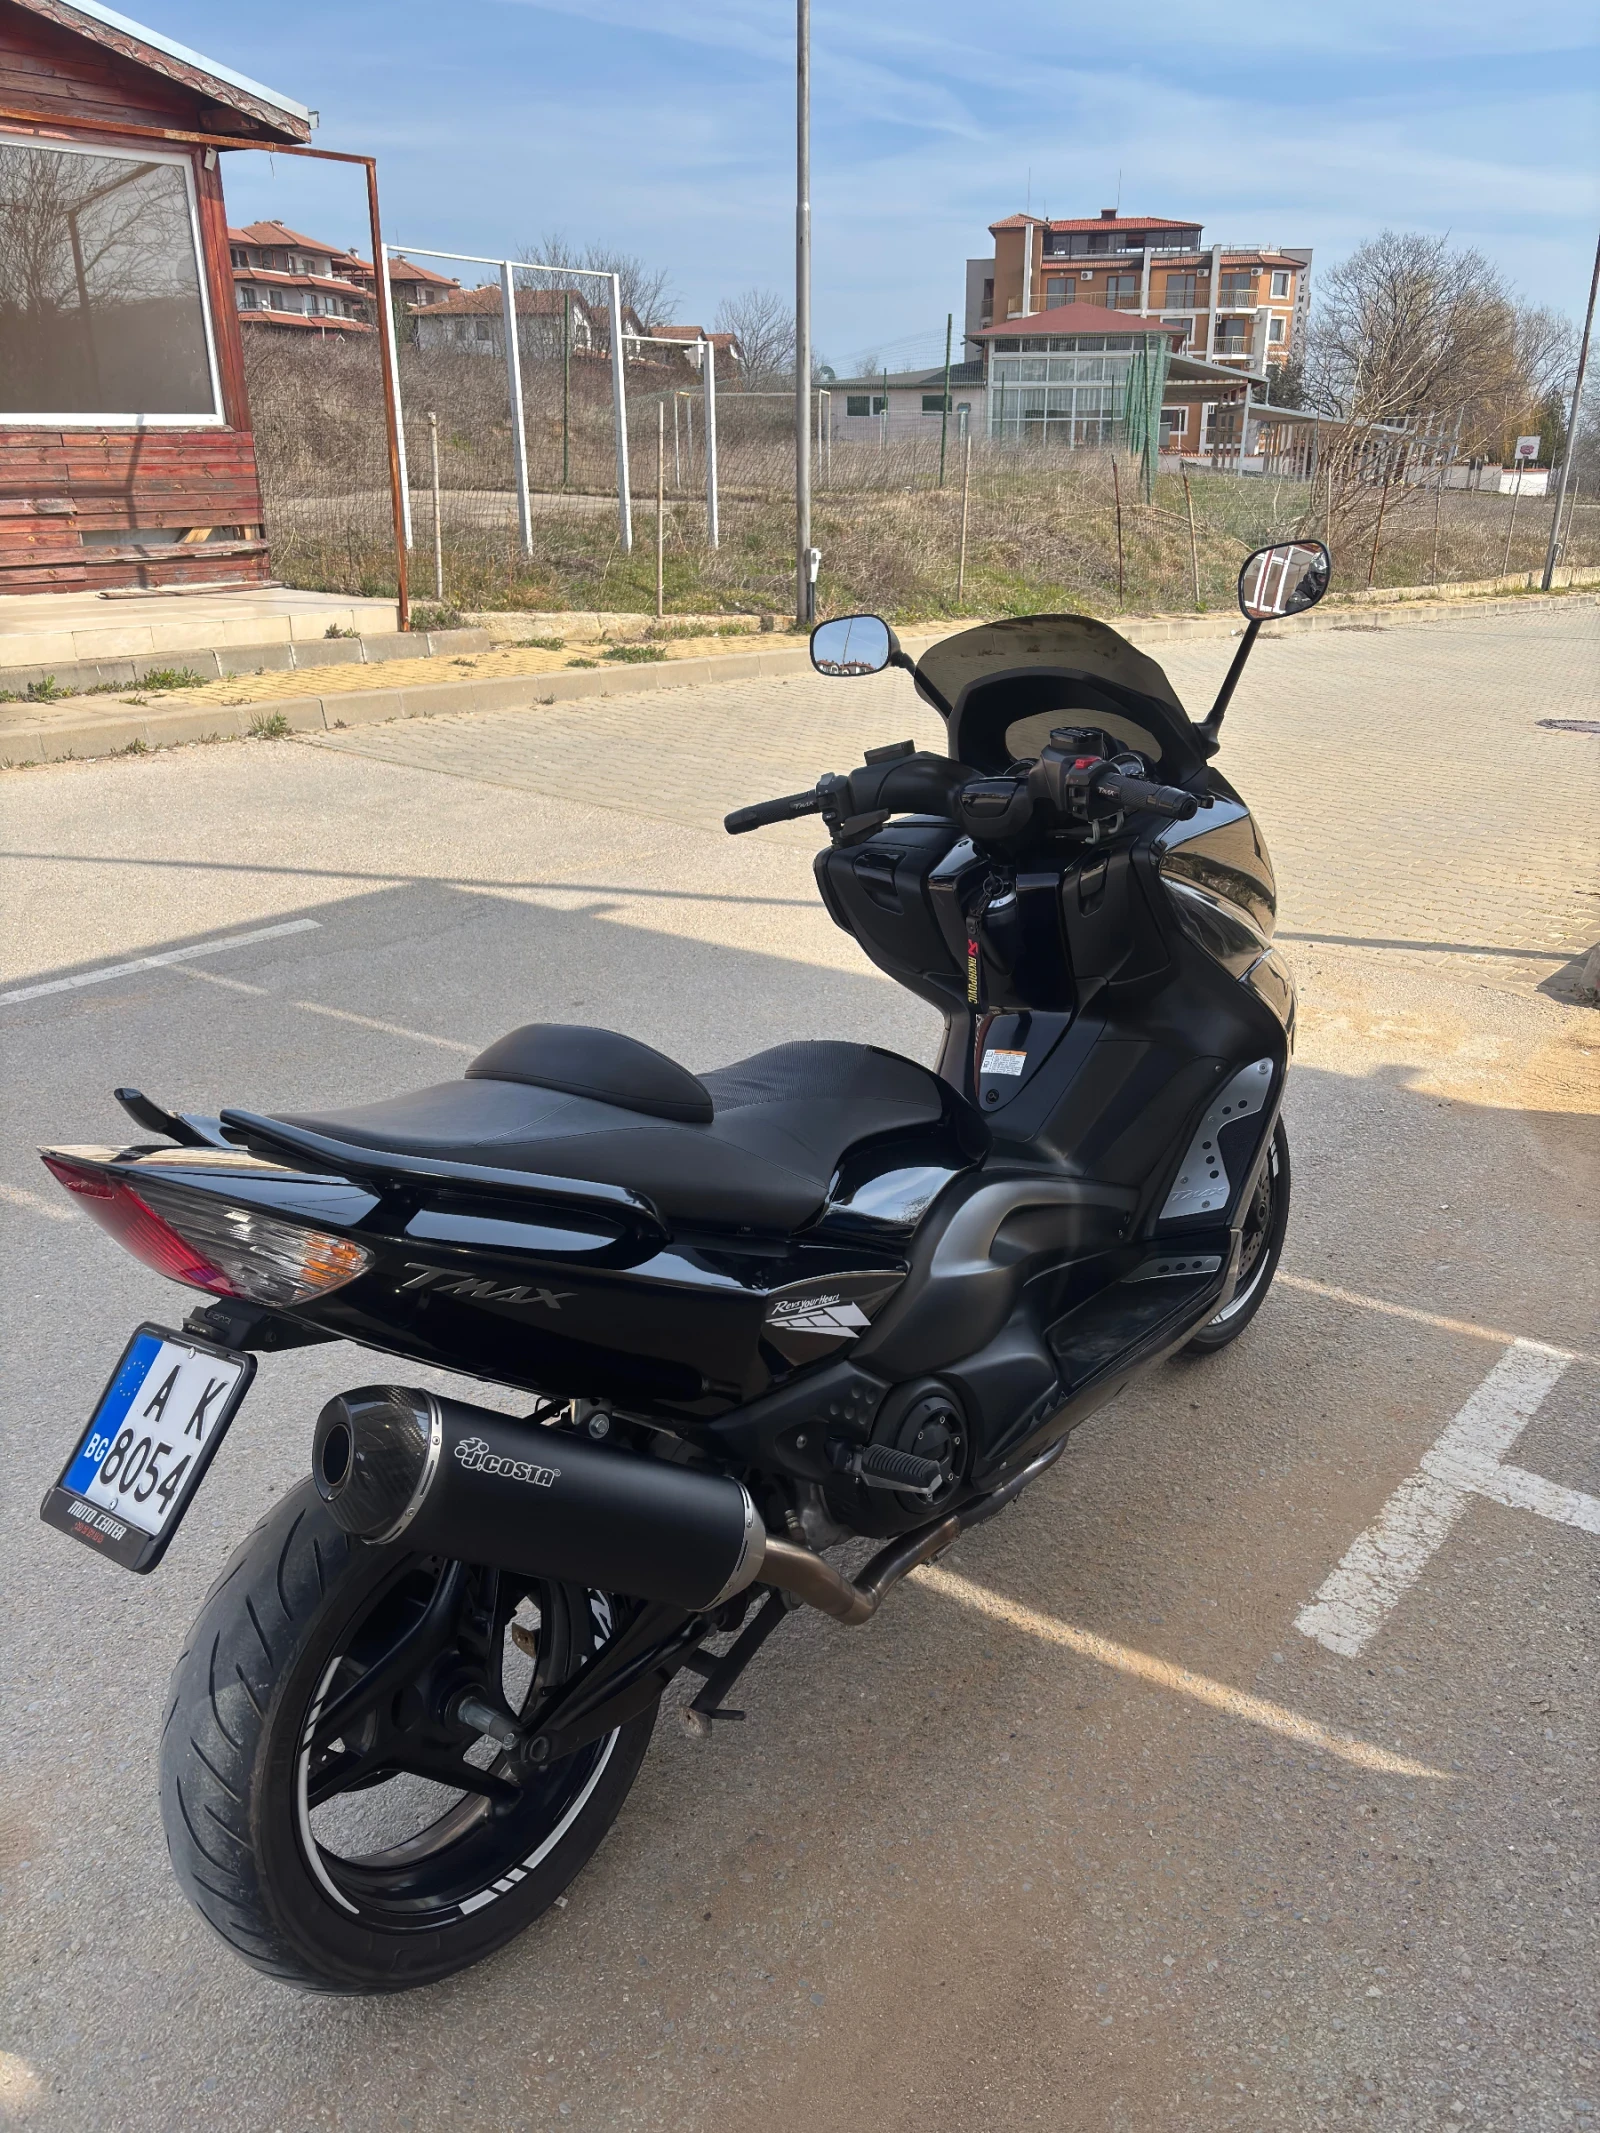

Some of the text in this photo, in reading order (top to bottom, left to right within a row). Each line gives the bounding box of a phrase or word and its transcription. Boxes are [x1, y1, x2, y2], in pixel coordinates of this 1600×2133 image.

[1295, 274, 1306, 334] VEMARA
[402, 1262, 579, 1309] TMAX
[143, 1364, 228, 1441] A K
[84, 1433, 109, 1462] BG
[100, 1428, 192, 1514] 8054
[67, 1500, 98, 1523] MOTO
[93, 1514, 127, 1541] CENTER
